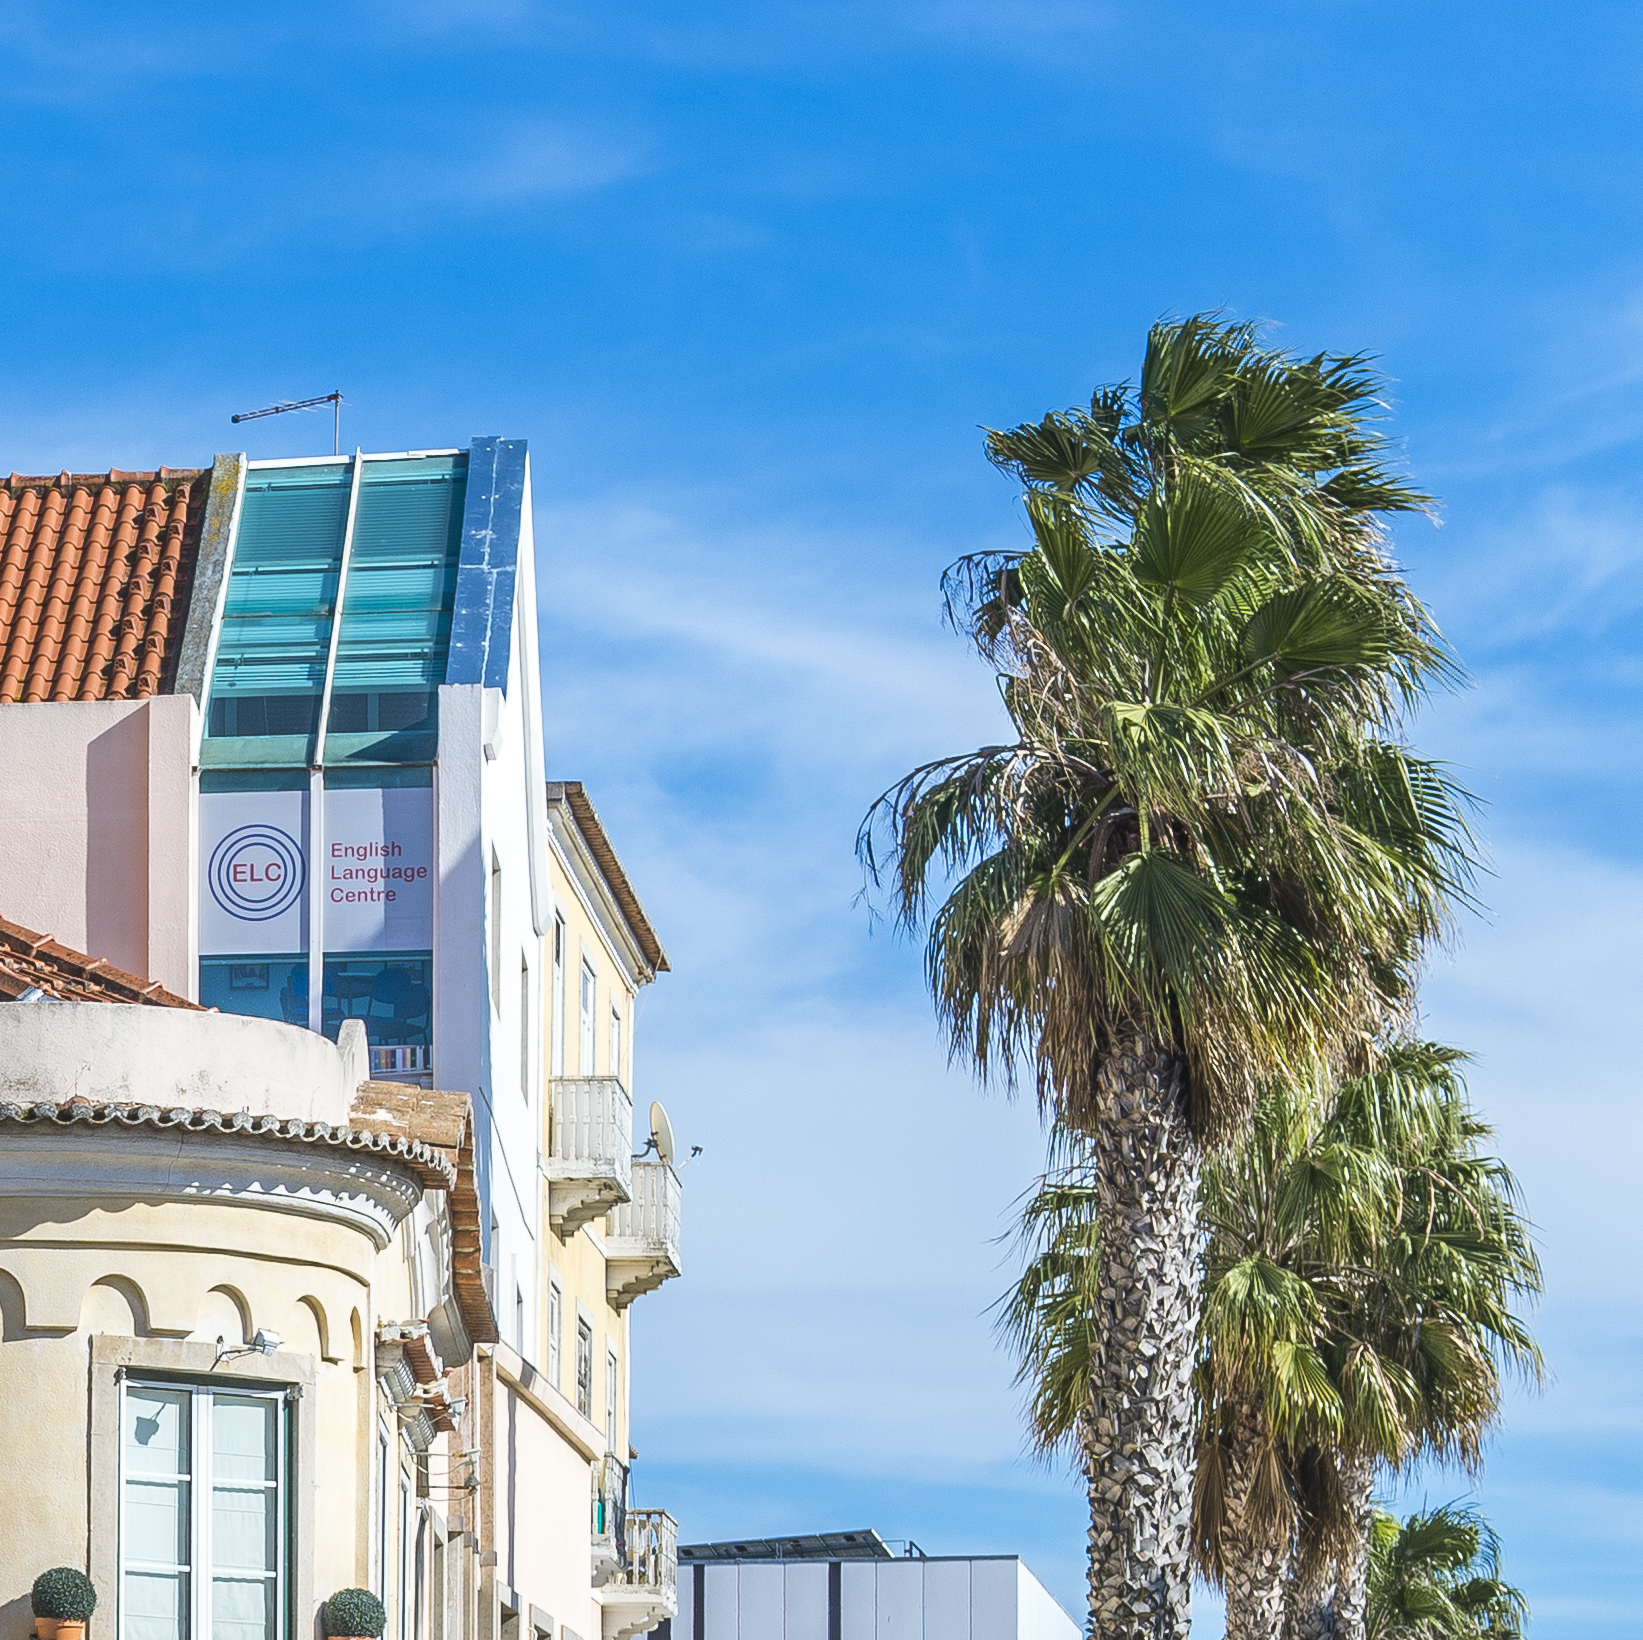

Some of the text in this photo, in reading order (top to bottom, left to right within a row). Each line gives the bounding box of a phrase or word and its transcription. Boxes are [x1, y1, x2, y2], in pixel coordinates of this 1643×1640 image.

[331, 841, 402, 861] English
[232, 862, 282, 882] ELC
[331, 864, 428, 883] Language
[330, 887, 397, 903] Centre
